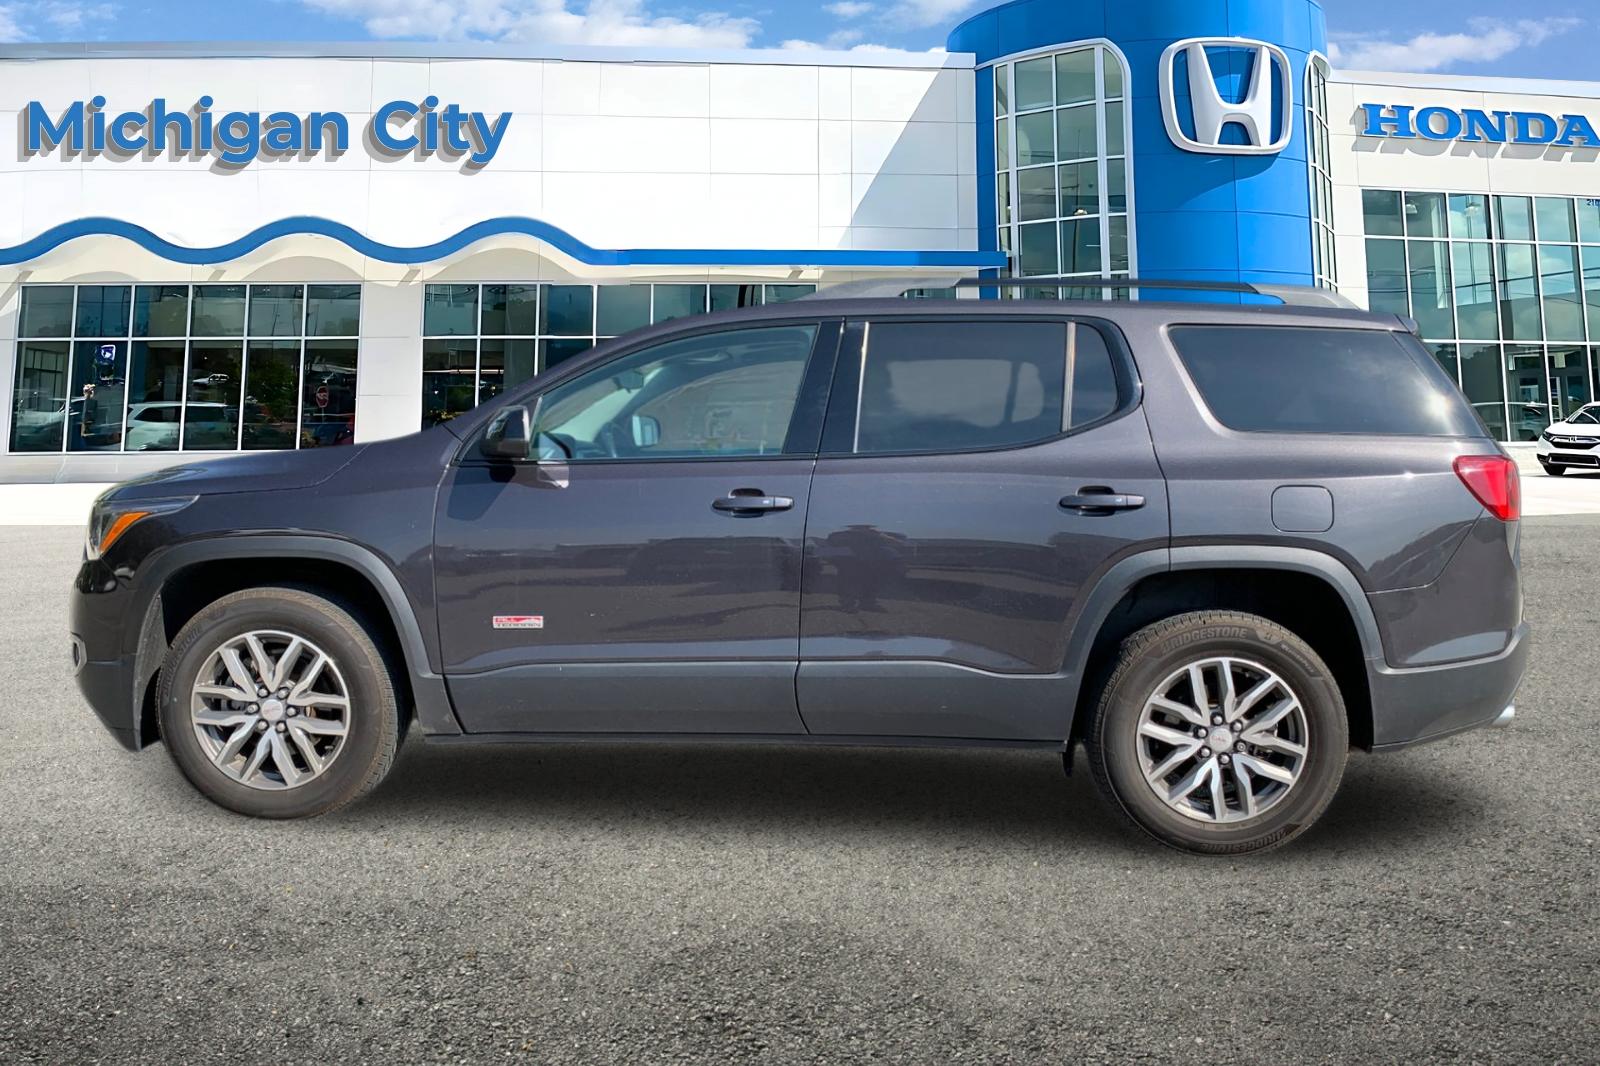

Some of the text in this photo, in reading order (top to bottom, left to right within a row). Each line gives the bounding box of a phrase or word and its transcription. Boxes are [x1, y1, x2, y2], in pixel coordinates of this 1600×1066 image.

[27, 95, 513, 164] Michigan City
[1361, 103, 1600, 147] HONDA
